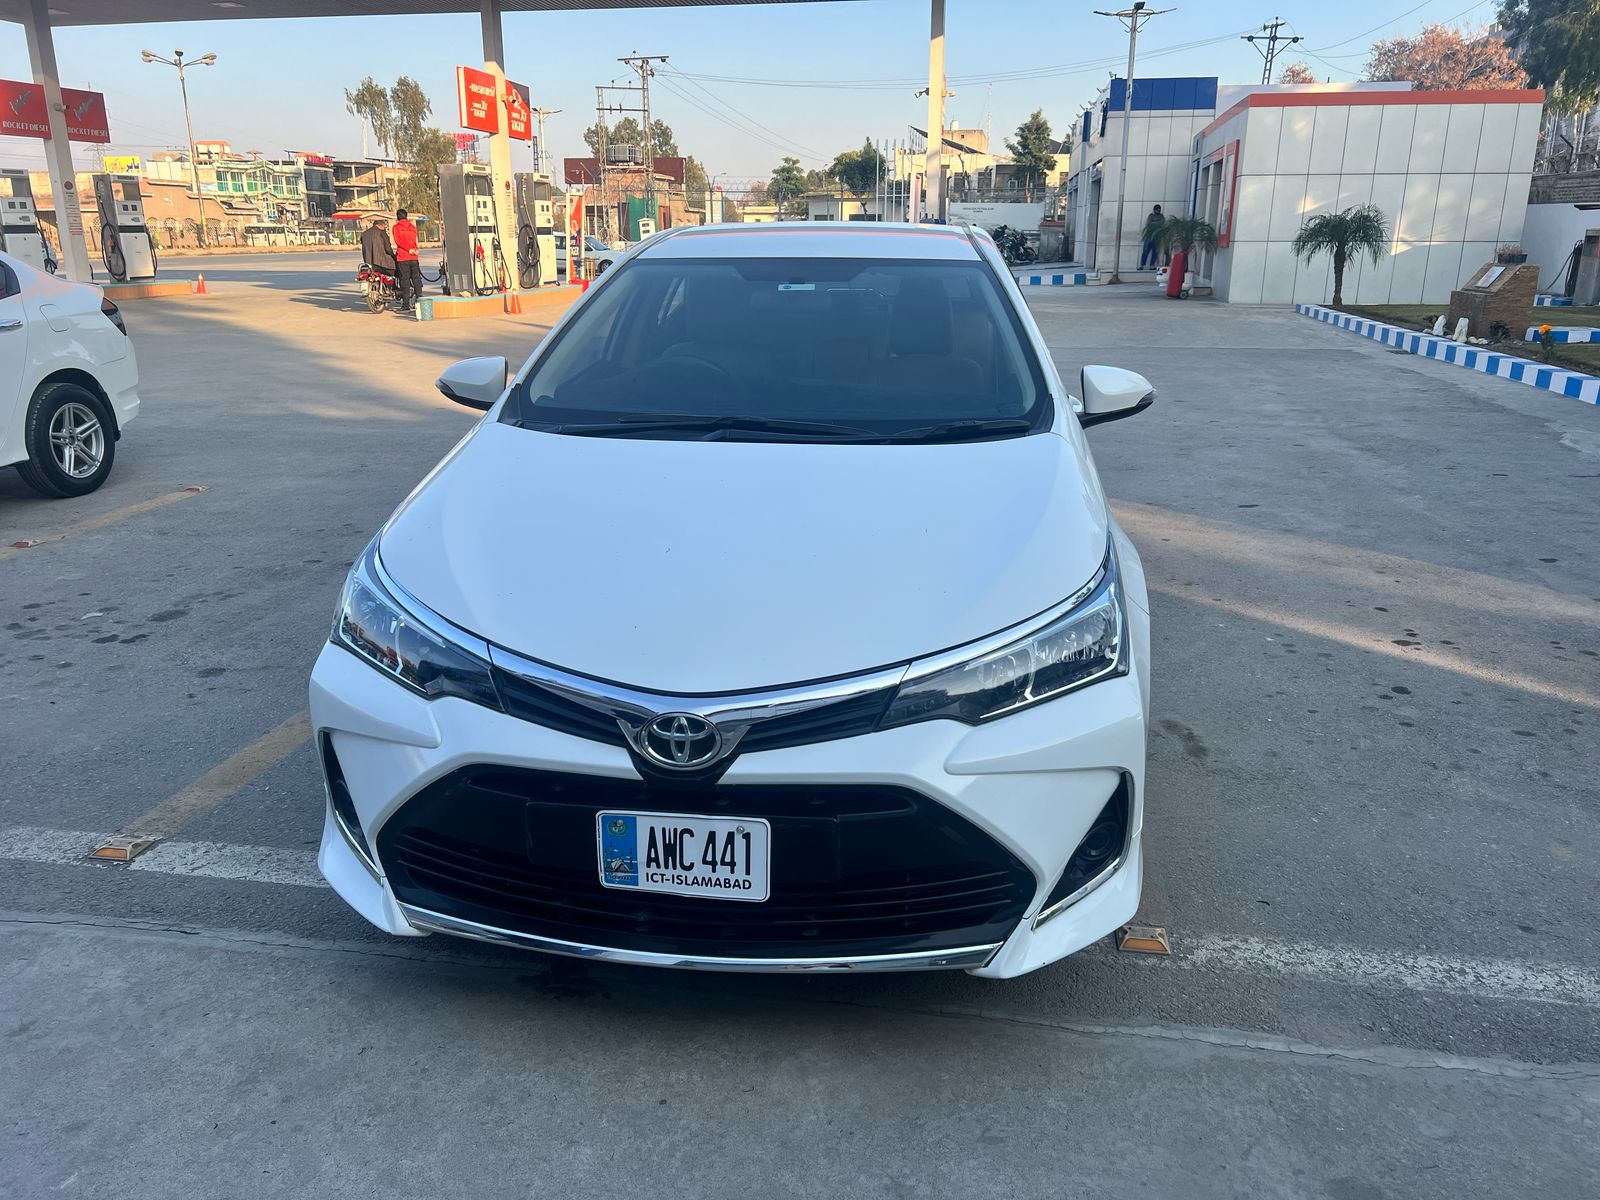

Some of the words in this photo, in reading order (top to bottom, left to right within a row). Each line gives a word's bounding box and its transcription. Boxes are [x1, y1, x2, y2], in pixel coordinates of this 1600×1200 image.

[2, 121, 29, 130] ROCKET
[29, 123, 49, 132] DIESEL
[67, 127, 90, 135] ROCKET
[645, 825, 695, 872] AWC
[701, 829, 752, 876] 441
[645, 871, 752, 890] ICT-ISLAMABAD
